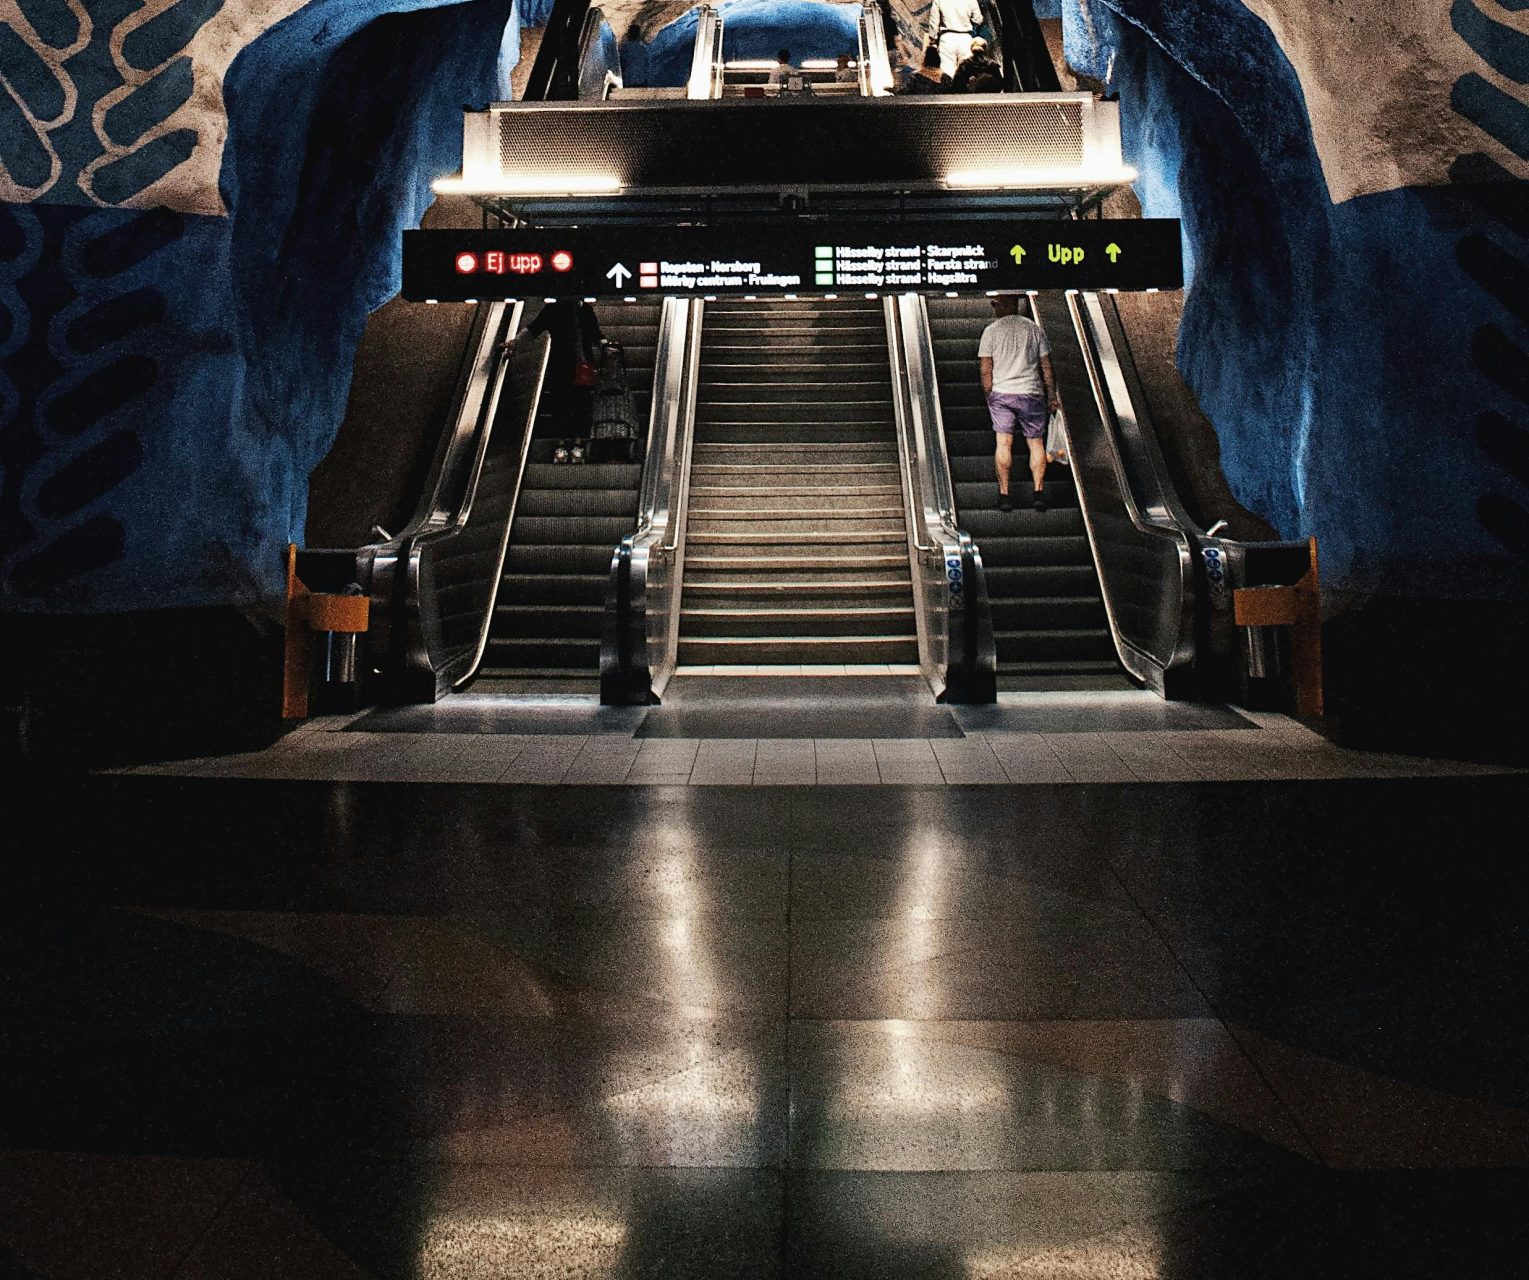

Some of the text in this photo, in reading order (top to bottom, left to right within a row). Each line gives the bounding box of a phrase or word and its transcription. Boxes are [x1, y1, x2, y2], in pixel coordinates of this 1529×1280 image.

[885, 246, 920, 257] strand
[1048, 244, 1084, 265] Upp
[487, 252, 541, 274] Ej upp
[885, 259, 920, 270] strand
[927, 259, 962, 270] Farsta
[963, 259, 998, 269] strand
[697, 274, 742, 286] centrum
[885, 272, 921, 284] strand
